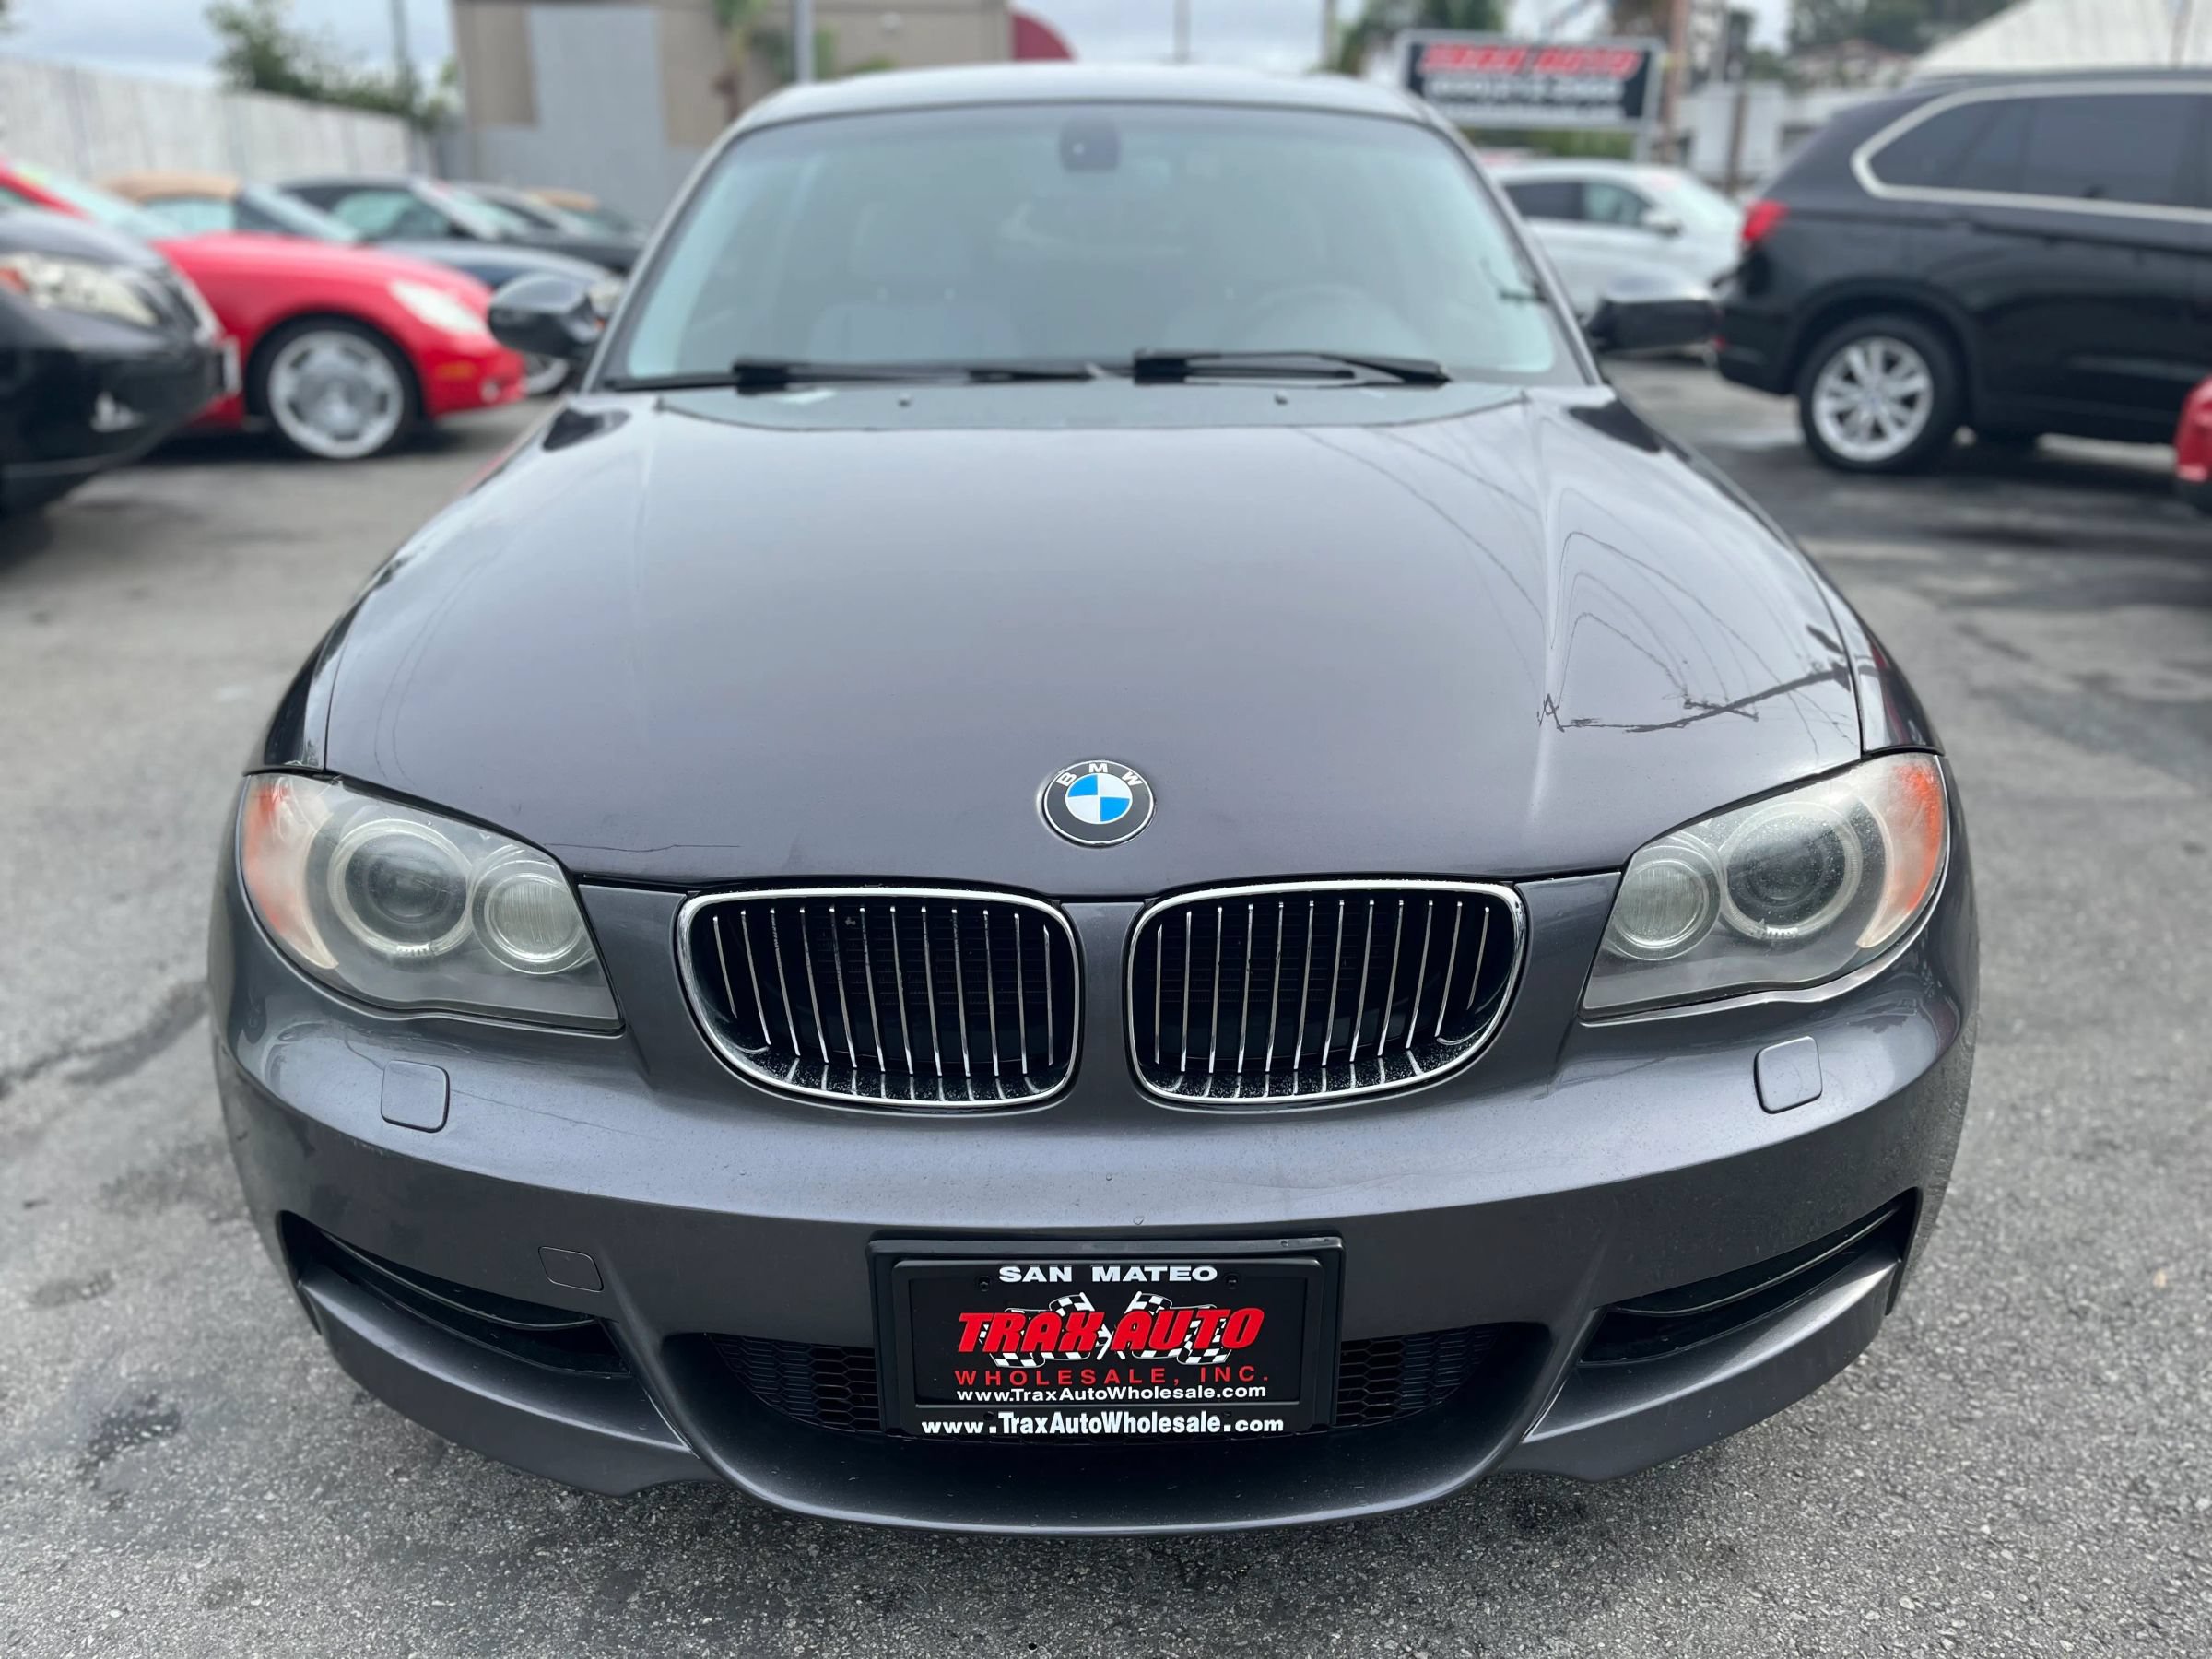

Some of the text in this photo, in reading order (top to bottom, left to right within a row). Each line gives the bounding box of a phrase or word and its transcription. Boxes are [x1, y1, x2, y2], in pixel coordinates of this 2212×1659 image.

[1055, 762, 1144, 787] BMW
[998, 1265, 1218, 1283] SAN MATEO
[958, 1307, 1265, 1353] TRAX AUTO
[954, 1366, 1268, 1387] WHOLESALE, INC.
[956, 1385, 1266, 1402] www.TraxAutoWholesale.com
